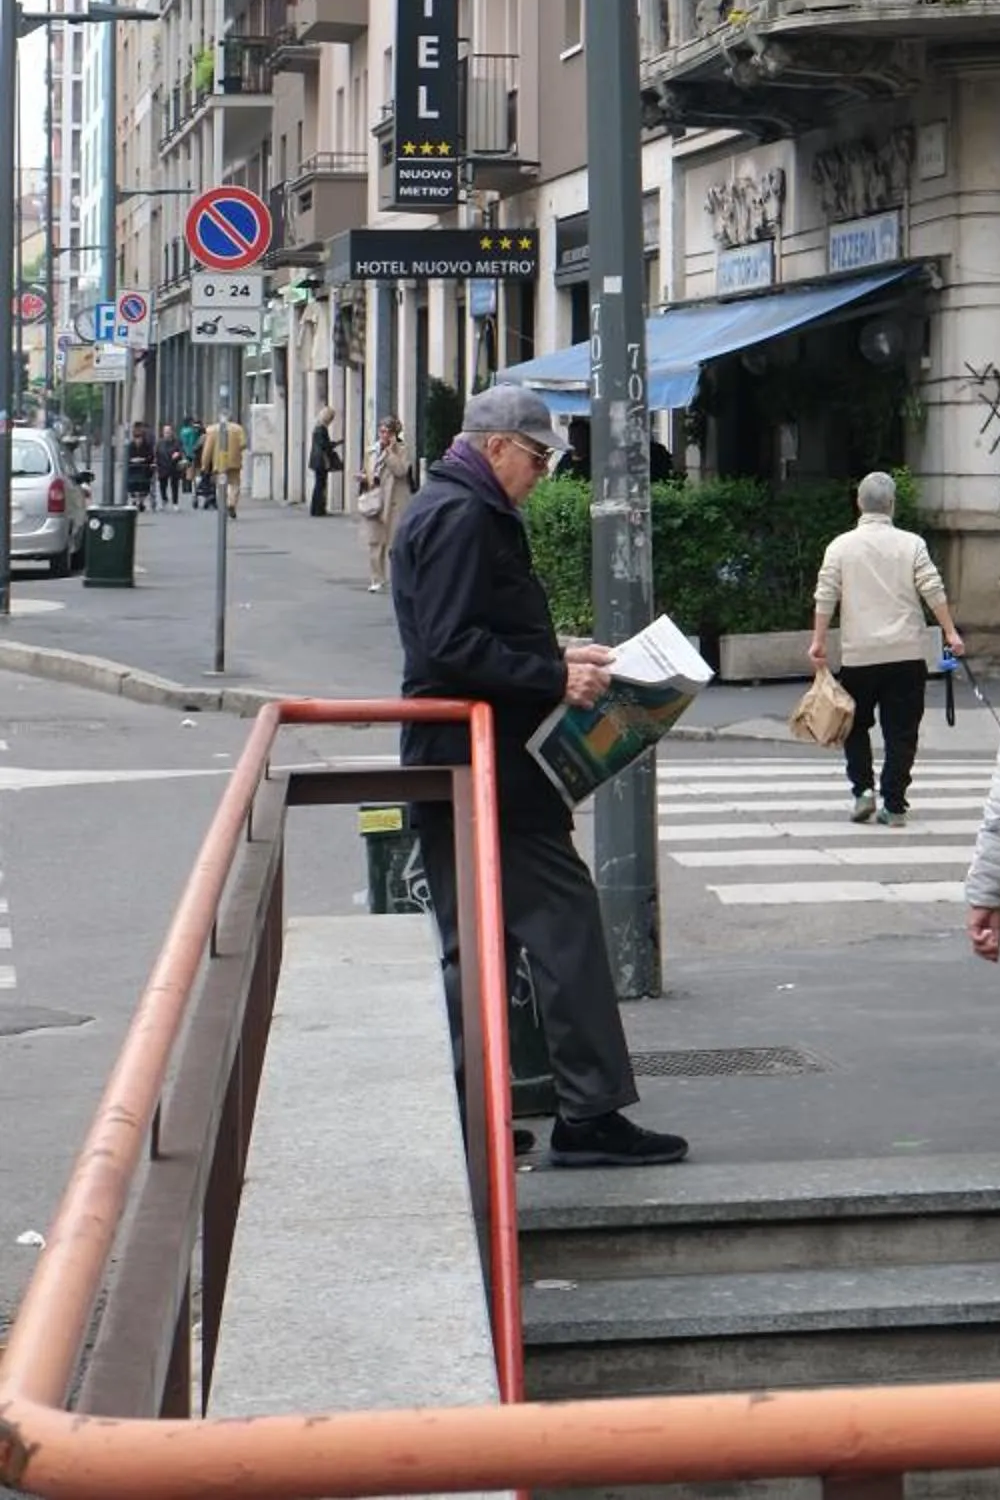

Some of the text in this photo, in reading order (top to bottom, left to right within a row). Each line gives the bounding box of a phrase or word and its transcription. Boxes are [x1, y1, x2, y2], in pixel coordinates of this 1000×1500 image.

[400, 169, 453, 180] NUOVO
[832, 227, 878, 268] PIZZERIA
[356, 261, 408, 274] HOTEL
[412, 260, 472, 275] NUOVO
[203, 285, 215, 297] 0
[230, 284, 250, 297] 24
